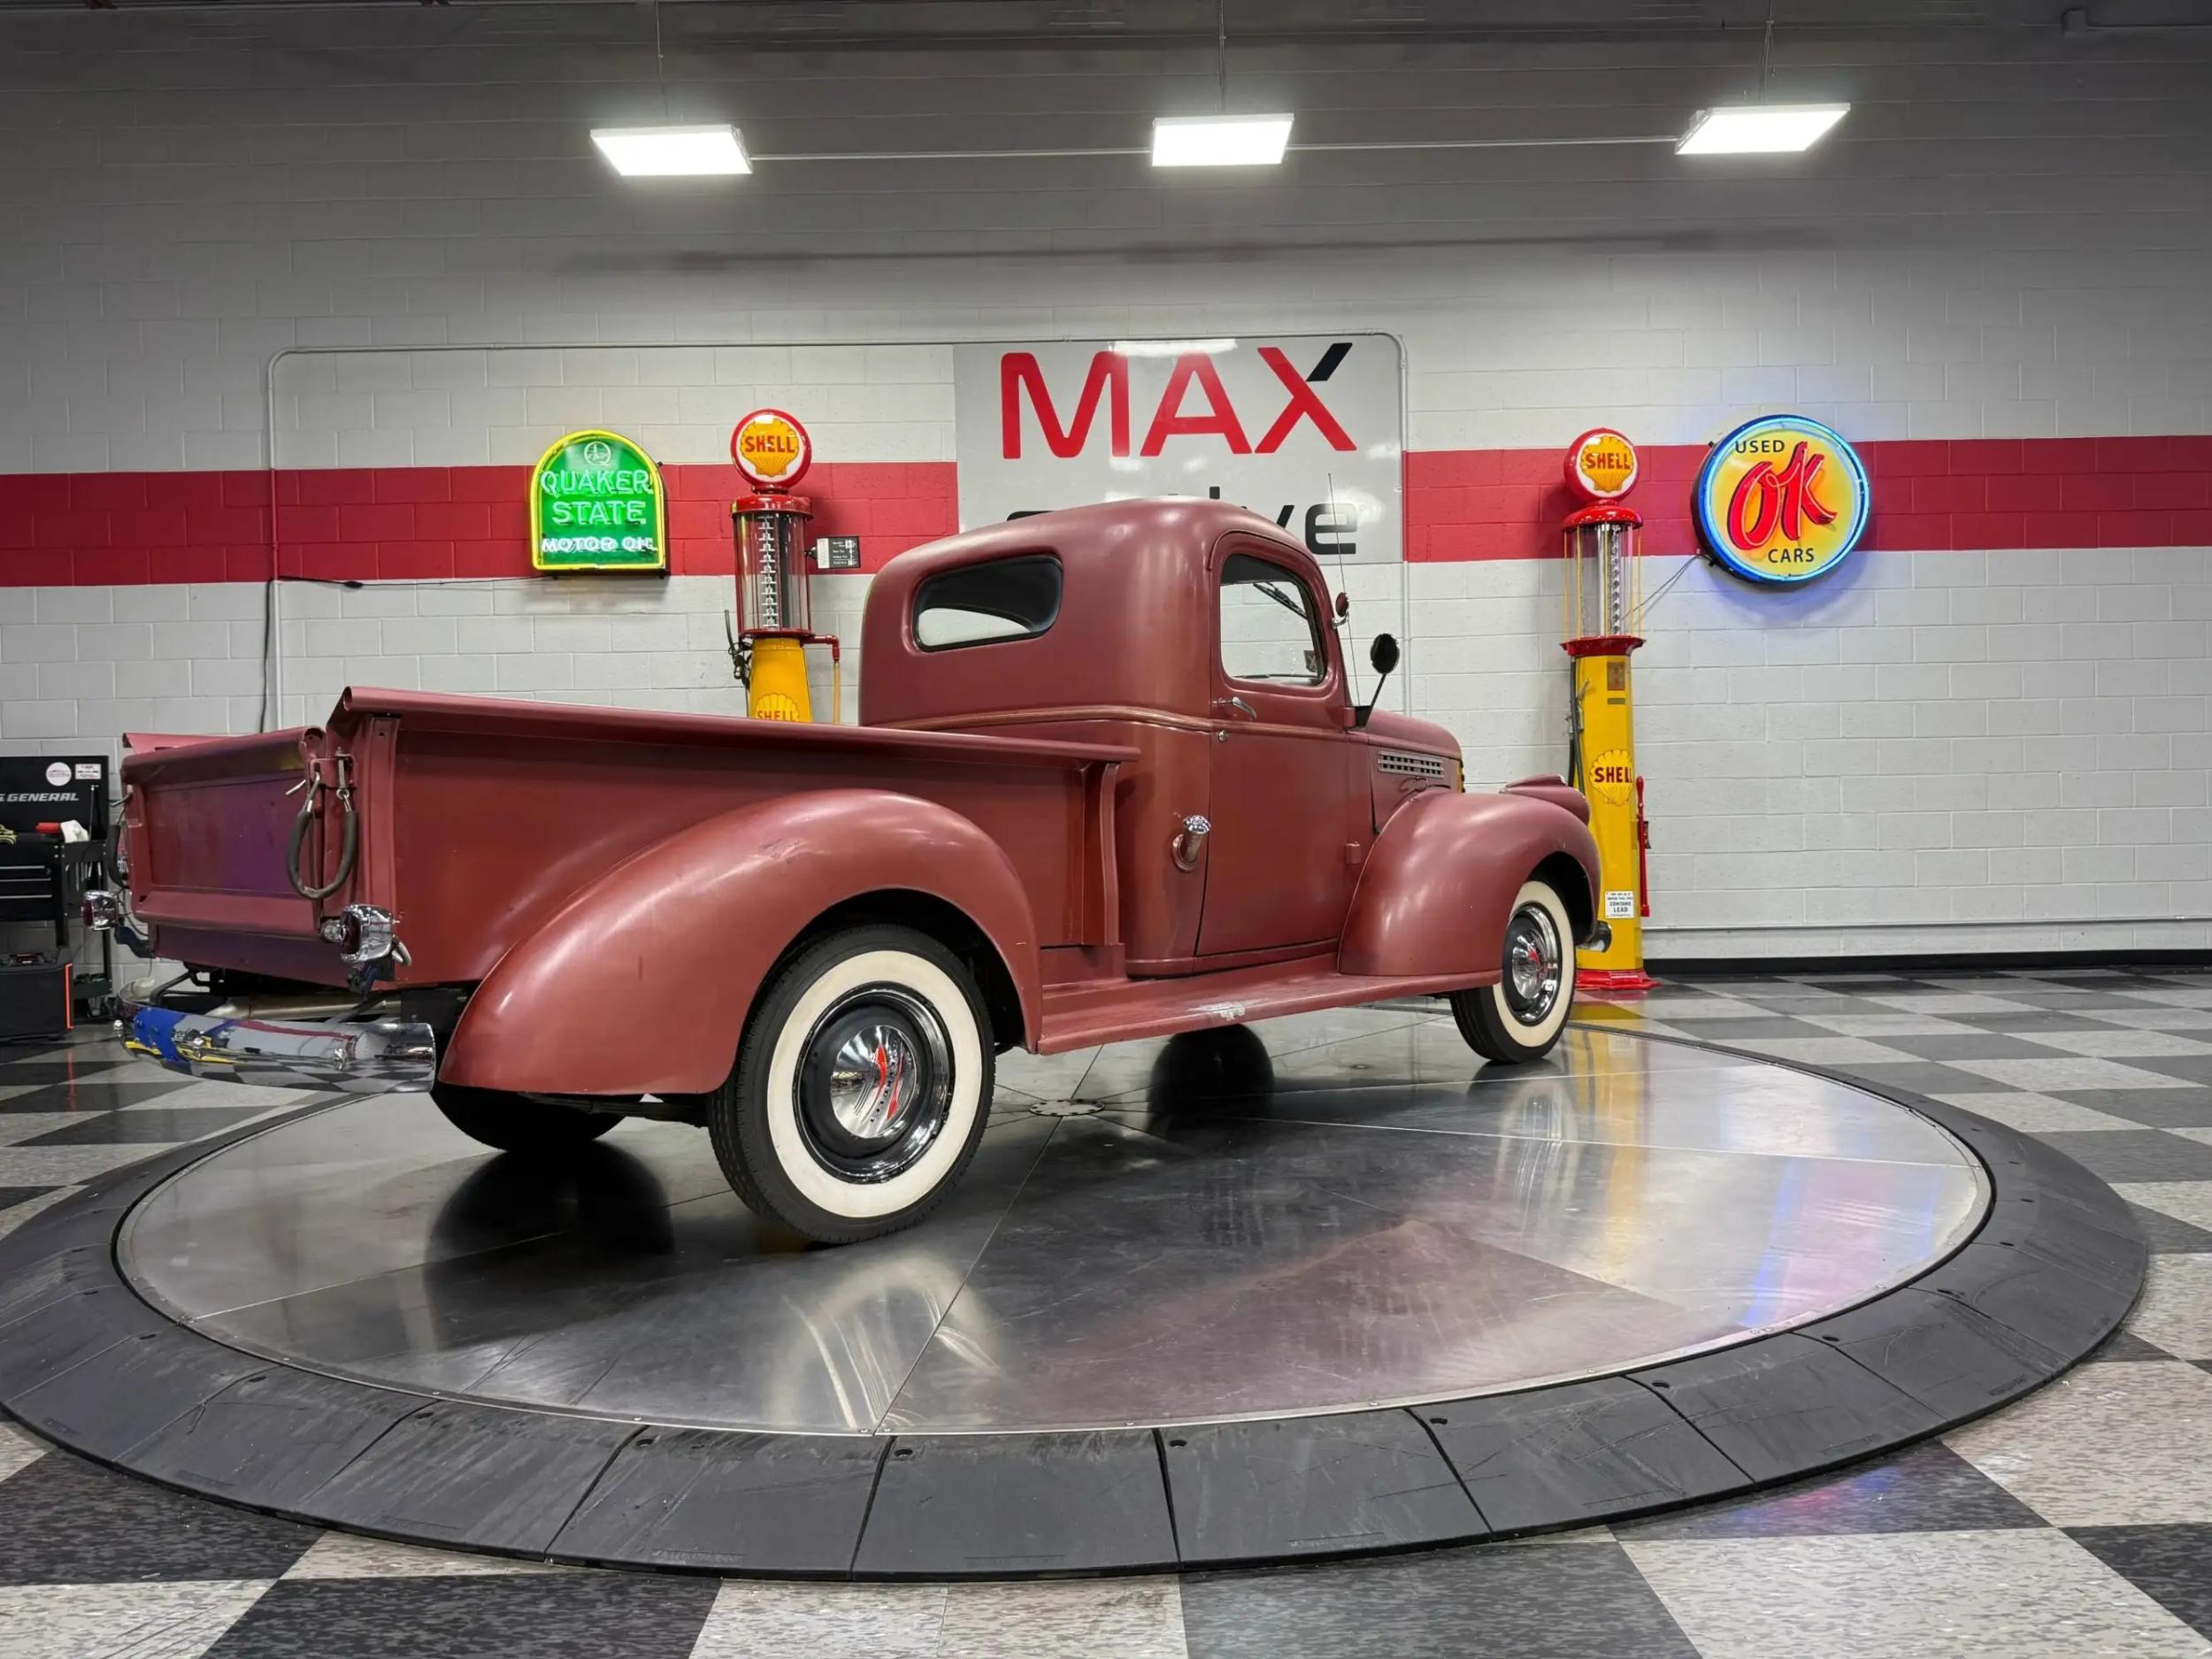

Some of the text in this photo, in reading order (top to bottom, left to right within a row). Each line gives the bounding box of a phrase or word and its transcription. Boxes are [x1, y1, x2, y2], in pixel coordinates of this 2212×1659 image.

[1001, 342, 1357, 459] MAX
[744, 434, 795, 453] SHELL
[1735, 441, 1785, 453] USED
[1586, 452, 1631, 470] SHELL
[541, 469, 654, 498] QUAKER
[1727, 442, 1838, 550] OK
[552, 500, 647, 526] STATE
[541, 536, 657, 553] MOTOR OIL
[1768, 548, 1815, 564] CARS
[7, 793, 80, 803] GENERAL
